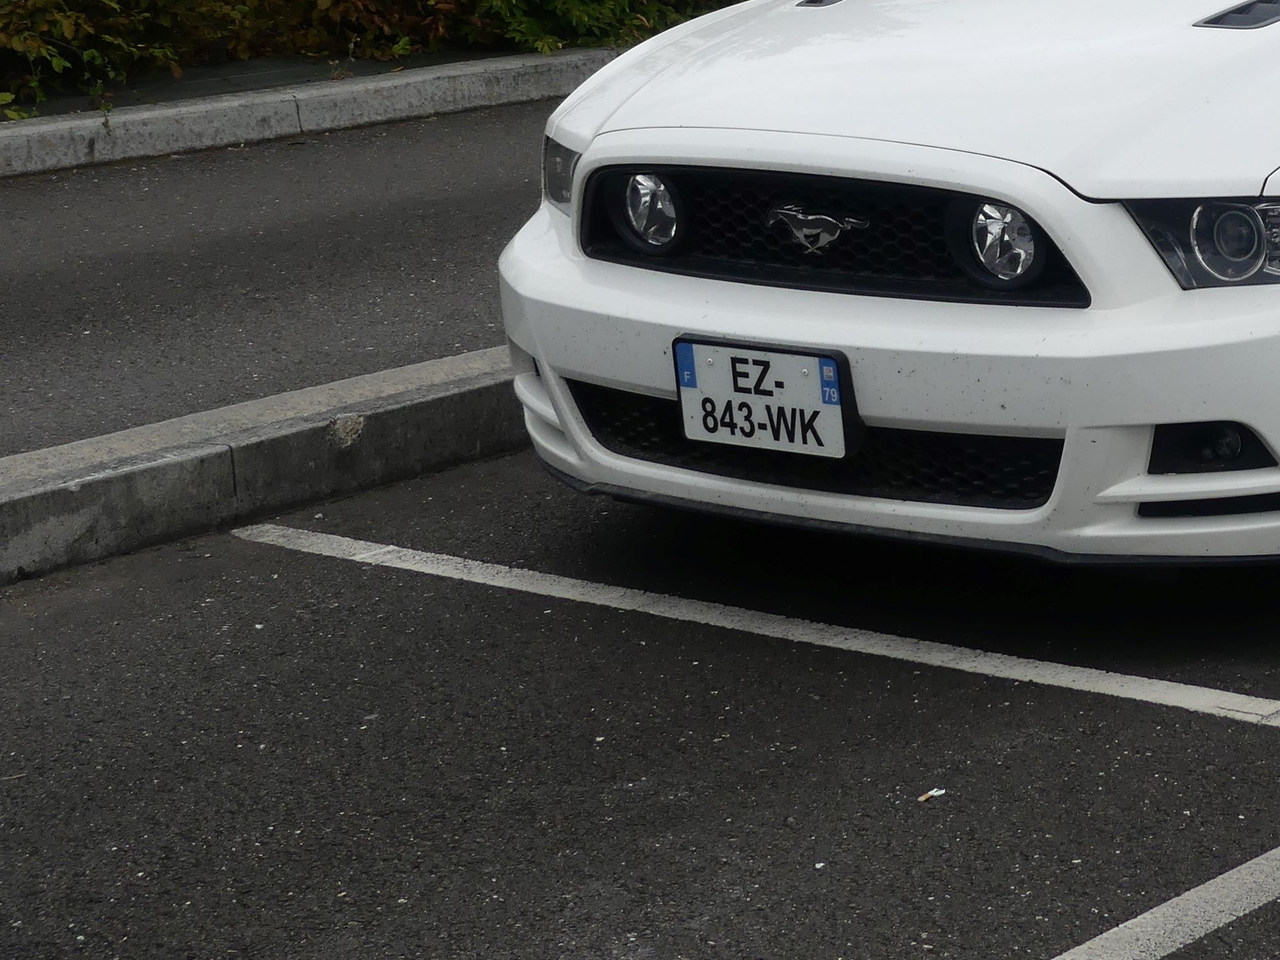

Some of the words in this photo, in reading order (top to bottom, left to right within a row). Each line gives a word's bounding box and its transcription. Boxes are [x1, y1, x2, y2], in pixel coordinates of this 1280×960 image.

[684, 371, 691, 382] F
[730, 356, 785, 397] EZ-
[823, 387, 838, 402] 79
[701, 397, 825, 447] 843-WK
